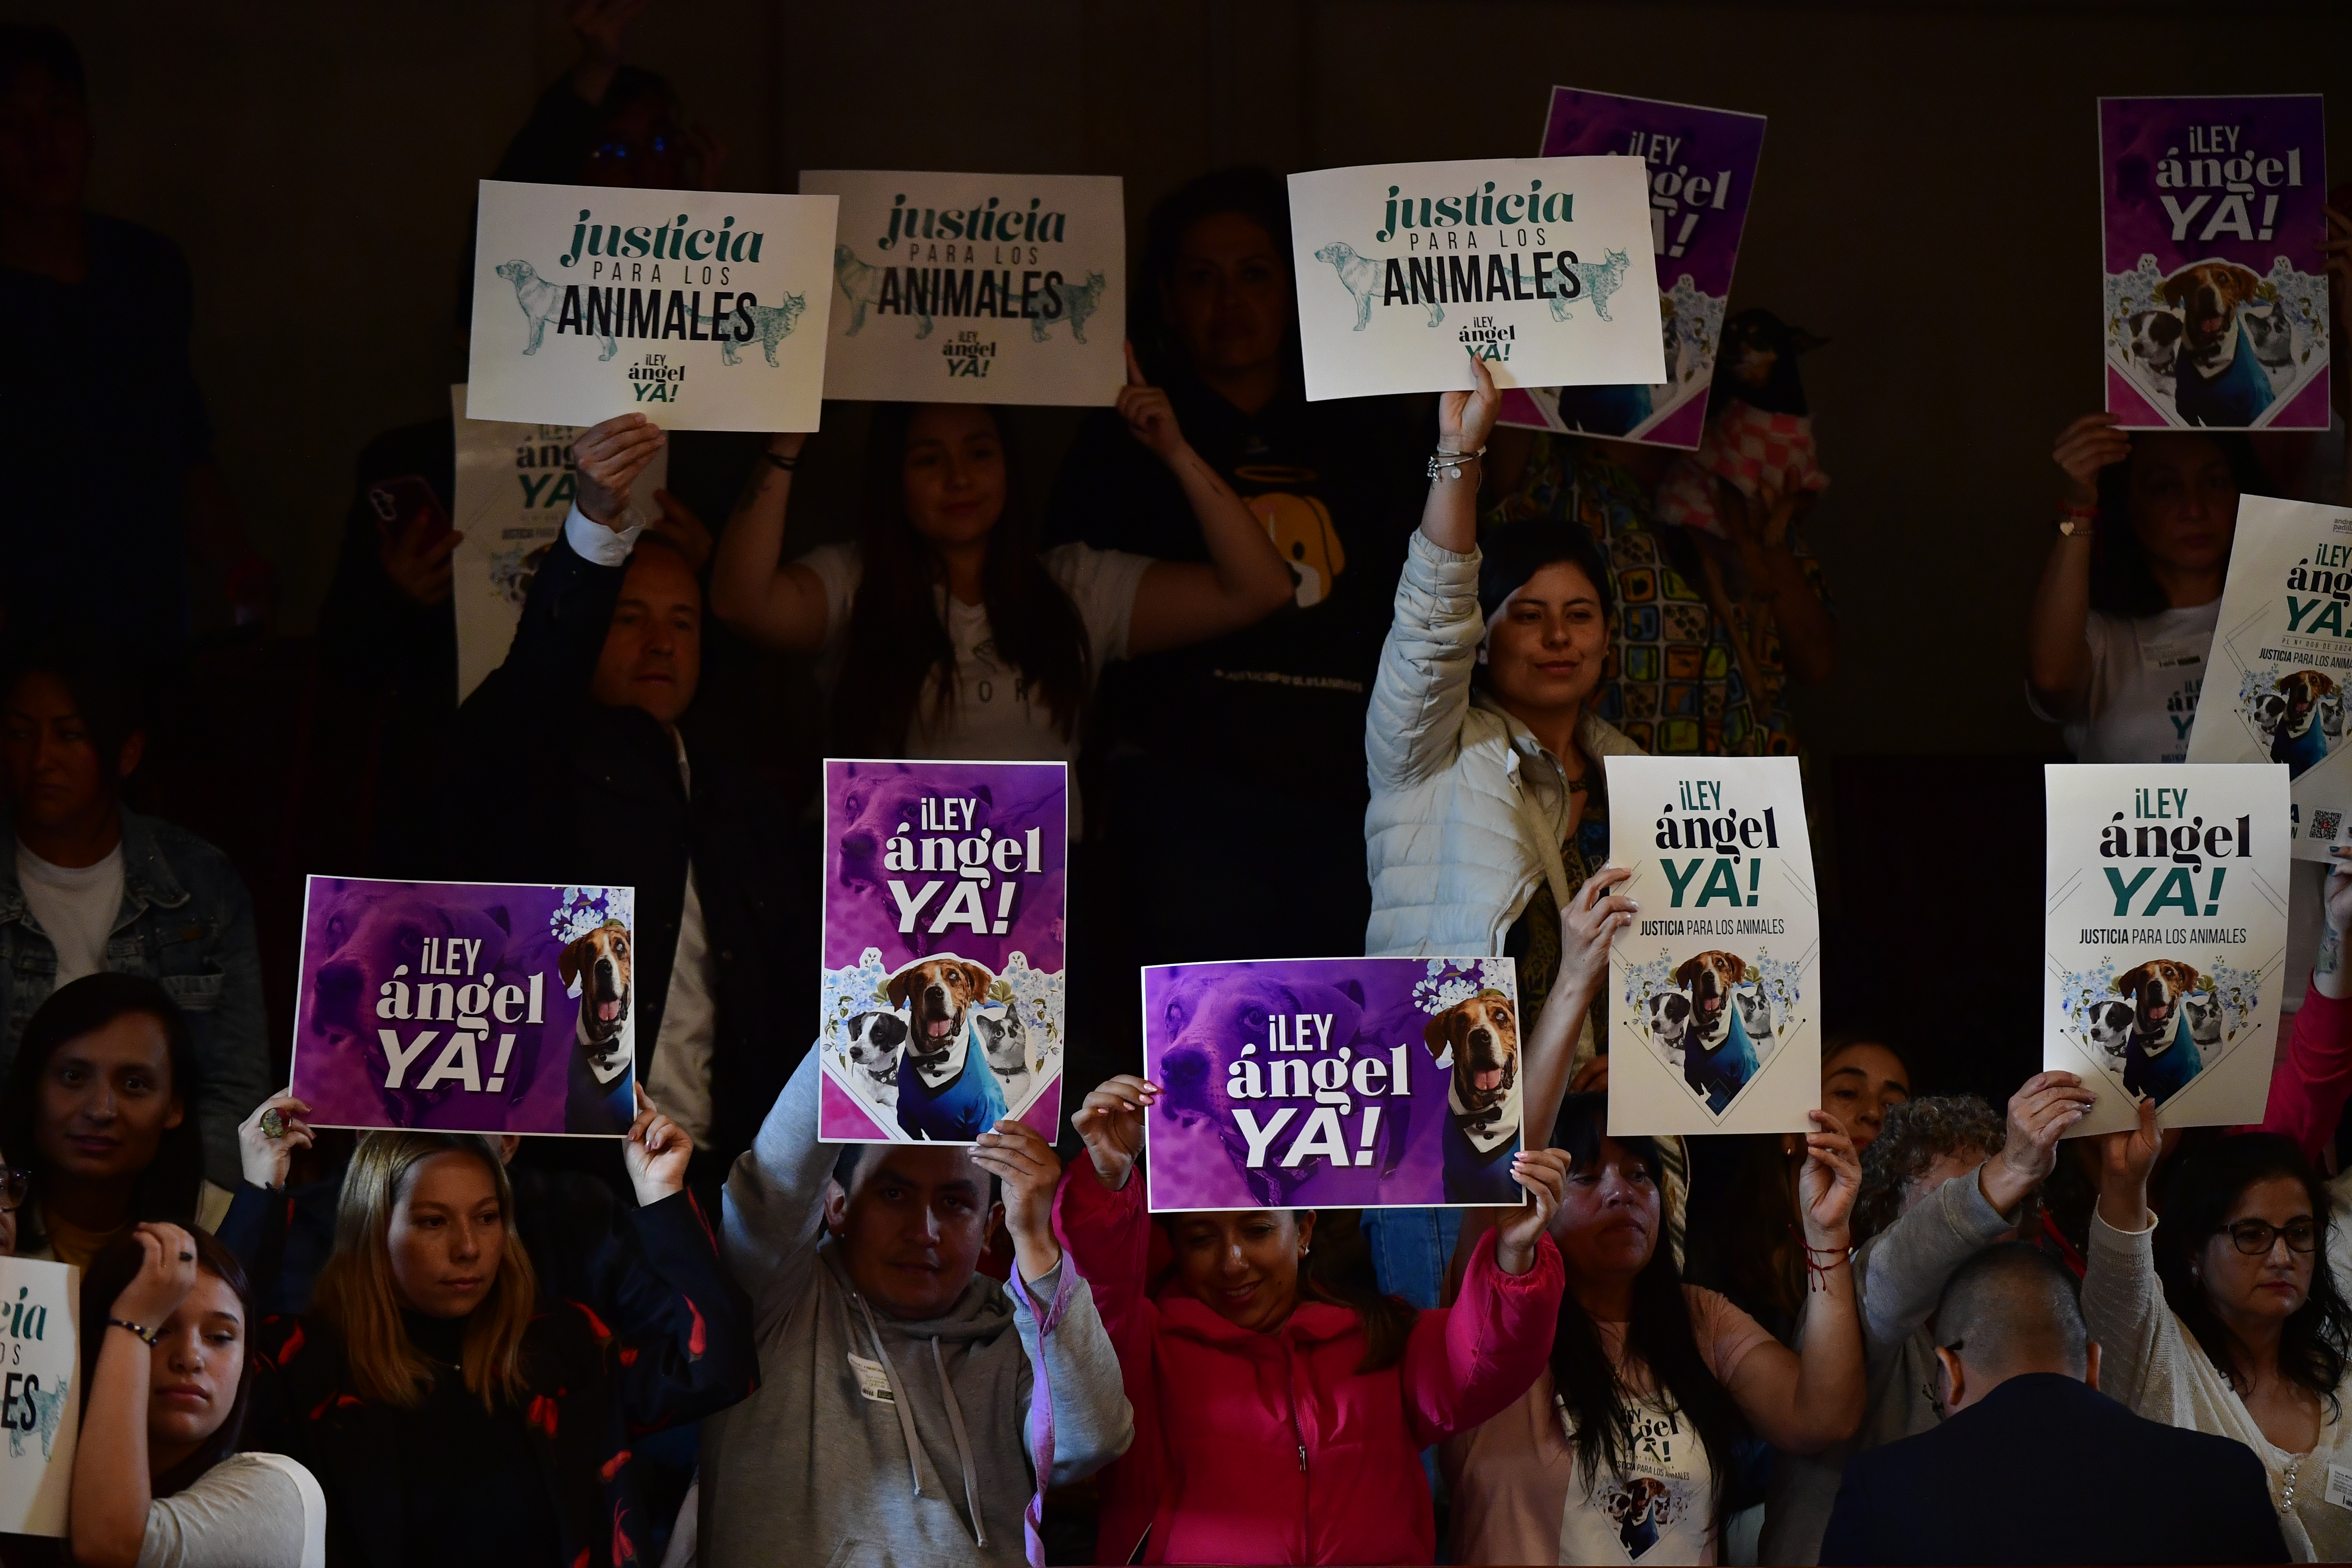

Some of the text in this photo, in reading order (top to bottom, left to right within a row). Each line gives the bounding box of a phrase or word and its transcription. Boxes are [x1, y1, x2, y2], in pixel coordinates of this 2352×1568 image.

[2189, 125, 2240, 153] ¡LEY
[1647, 165, 1732, 217] gel
[2155, 147, 2303, 201] ángel
[879, 194, 1066, 250] justicia
[1376, 180, 1574, 242] justicia
[2159, 194, 2280, 241] YA!
[561, 209, 764, 267] justicia
[910, 244, 1038, 264] PARA LOS
[1410, 228, 1546, 251] PARA LOS
[593, 261, 730, 286] PARA LOS
[878, 267, 1063, 318] ANIMALES
[1384, 250, 1581, 306] ANIMALES
[557, 285, 757, 342] ANIMALES
[1459, 324, 1516, 346] ángel
[942, 339, 996, 358] ángel
[947, 359, 990, 377] YA!
[628, 364, 685, 384] ángel
[633, 383, 679, 403] YA!
[518, 474, 577, 508] YA
[2259, 648, 2292, 662] JUSTICIA
[2293, 652, 2313, 665] PARA
[2315, 655, 2330, 667] LOS
[920, 798, 977, 831] ¡LEY
[1679, 781, 1720, 810] ¡LEY
[2136, 788, 2188, 819] ¡LEY
[1655, 803, 1780, 864] ángel
[2099, 811, 2252, 874] ángel
[883, 822, 1042, 889] ángel
[1659, 858, 1761, 907] YA!
[2103, 867, 2227, 916] YA!
[887, 880, 1016, 934] YA!
[1640, 918, 1784, 936] JUSTICIA PARA LOS ANIMALES
[420, 937, 482, 976] ¡LEY
[2079, 928, 2246, 945] JUSTICIA PARA LOS ANIMALES
[375, 964, 544, 1041] ángel
[1269, 1013, 1333, 1051] ¡LEY
[377, 1029, 517, 1092] YA!
[1226, 1043, 1411, 1116] ángel
[1231, 1106, 1382, 1168] YA!
[1616, 1460, 1635, 1471] STICIA
[1637, 1464, 1652, 1474] PARA
[1653, 1467, 1663, 1476] LOS
